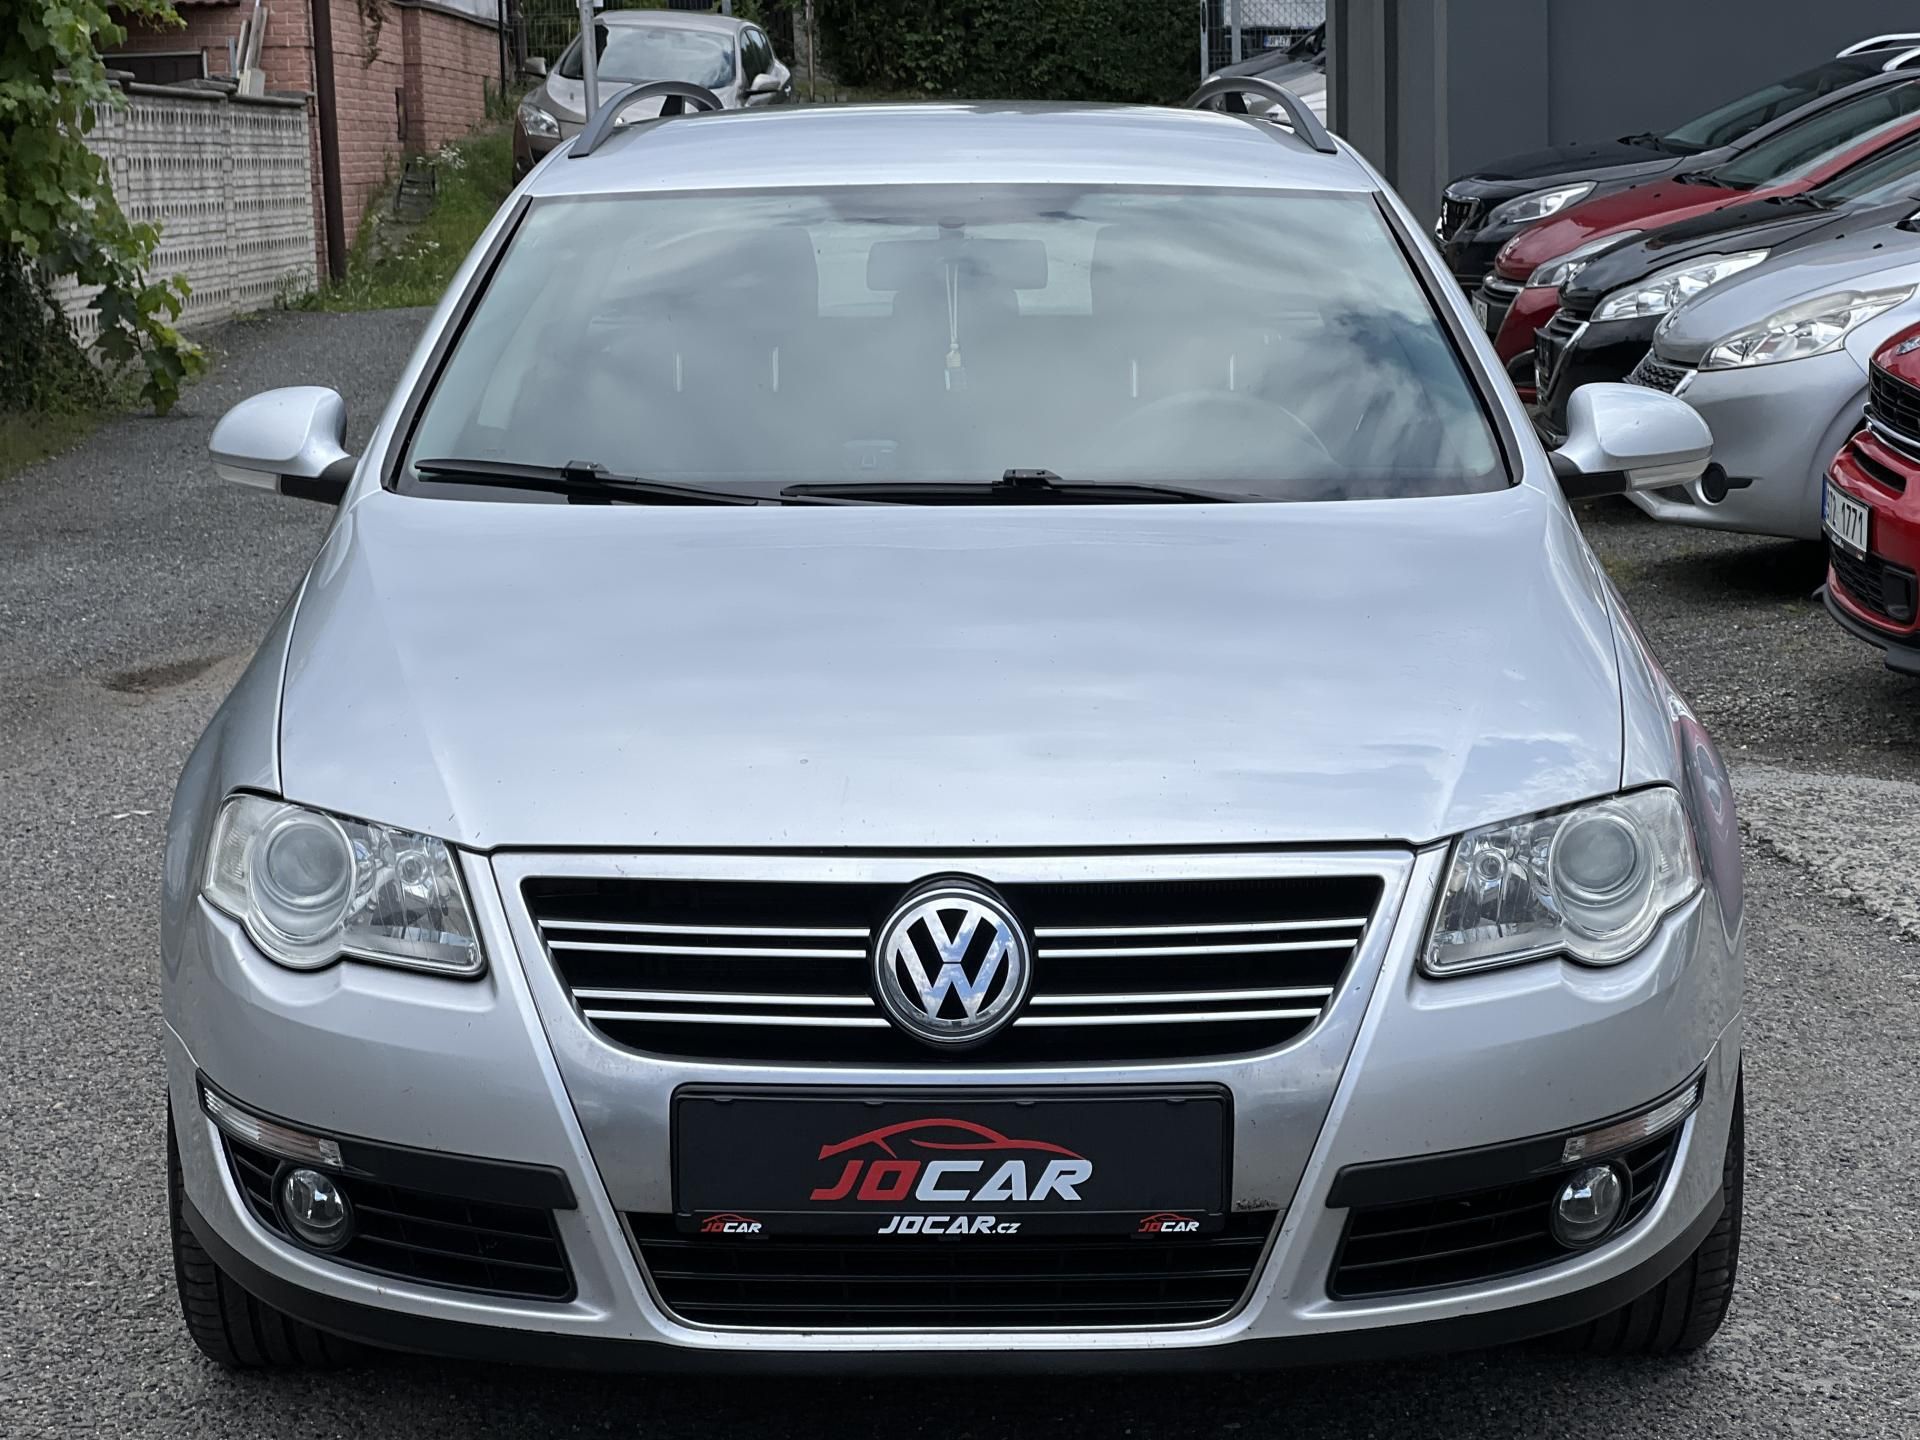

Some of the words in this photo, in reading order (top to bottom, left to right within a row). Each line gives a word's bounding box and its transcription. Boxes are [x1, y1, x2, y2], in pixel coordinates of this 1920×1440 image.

[1841, 502, 1863, 546] 1771
[810, 1160, 1093, 1201] JOCAR
[701, 1222, 762, 1233] JOCAR
[878, 1216, 1021, 1234] JOCAR.cz
[1138, 1221, 1200, 1232] JOCAR
